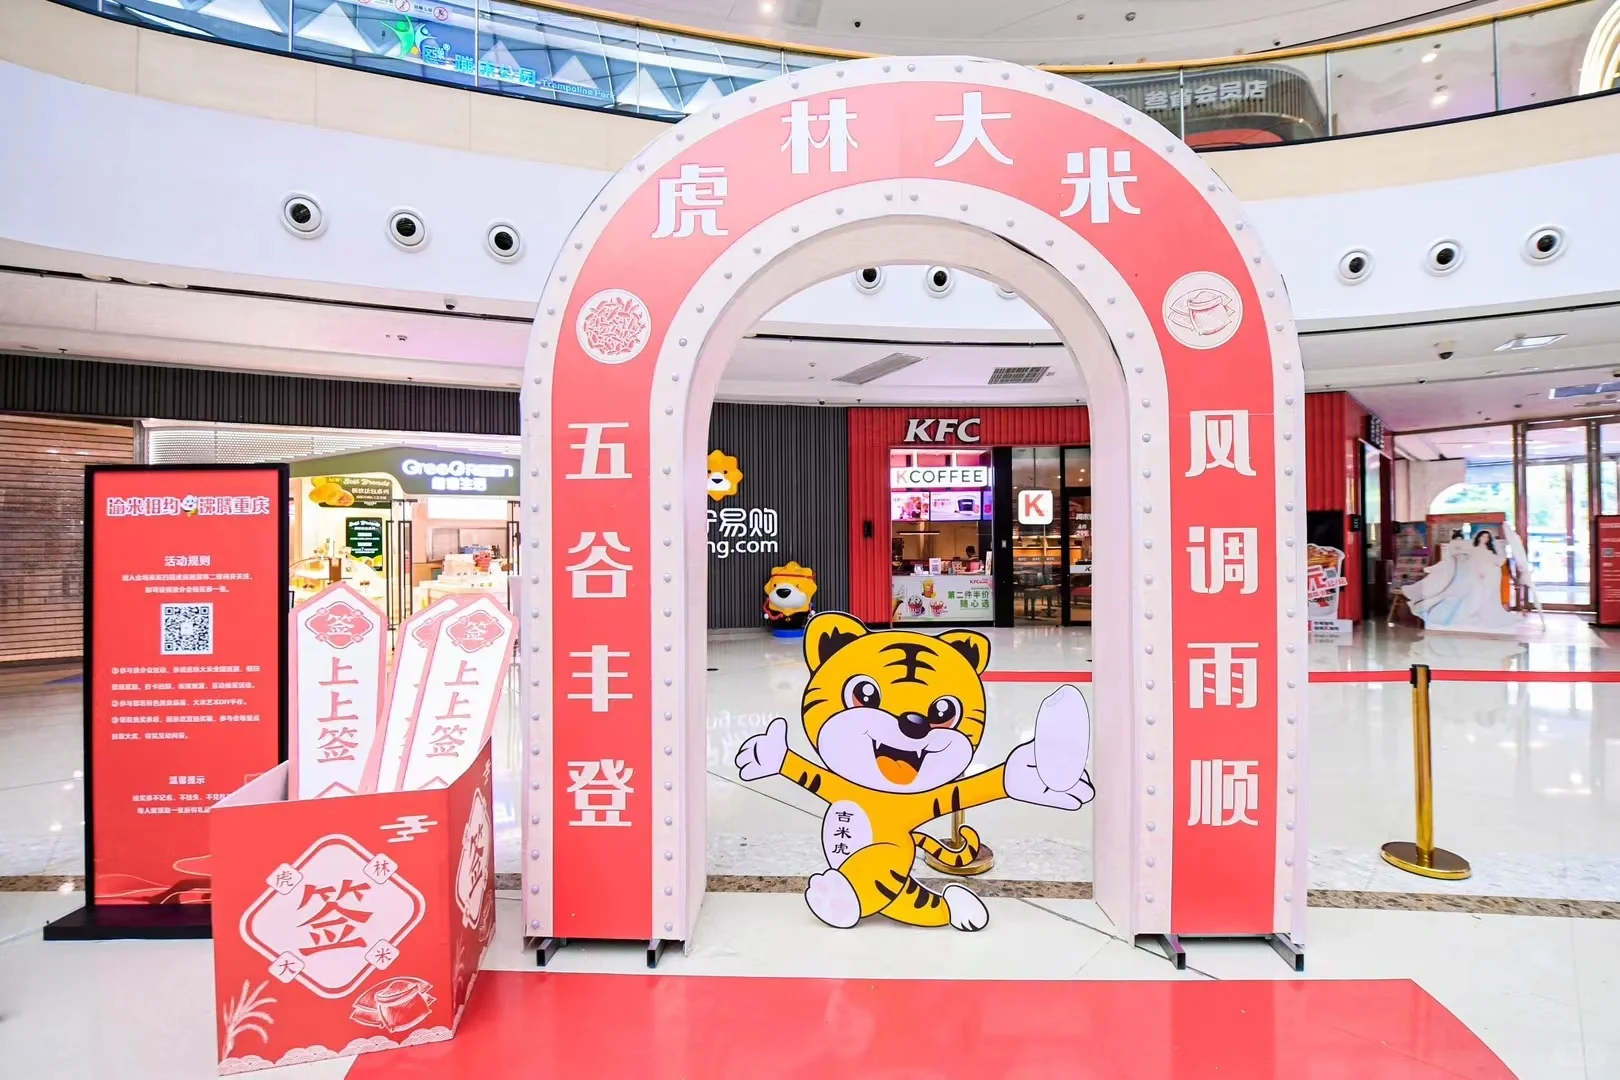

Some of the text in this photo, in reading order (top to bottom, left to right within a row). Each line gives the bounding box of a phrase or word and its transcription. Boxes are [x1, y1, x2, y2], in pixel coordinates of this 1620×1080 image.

[541, 78, 594, 96] Trampoline
[651, 91, 1141, 238] 虎林大米
[903, 417, 981, 443] KFC
[895, 468, 984, 485] KCOFFEE
[107, 495, 270, 517] 渝米相约 沸腾重庆
[164, 555, 211, 567] 活动规则
[947, 590, 990, 599] 第二件半价
[960, 599, 990, 608] 随心选
[326, 612, 353, 637] 签
[463, 620, 488, 641] 签
[566, 422, 634, 827] 五谷丰登
[1185, 409, 1259, 827] 风调雨顺
[315, 656, 359, 764] 上上签
[426, 659, 480, 758] 上上签
[831, 808, 855, 857] 吉米虎
[296, 879, 373, 957] 签
